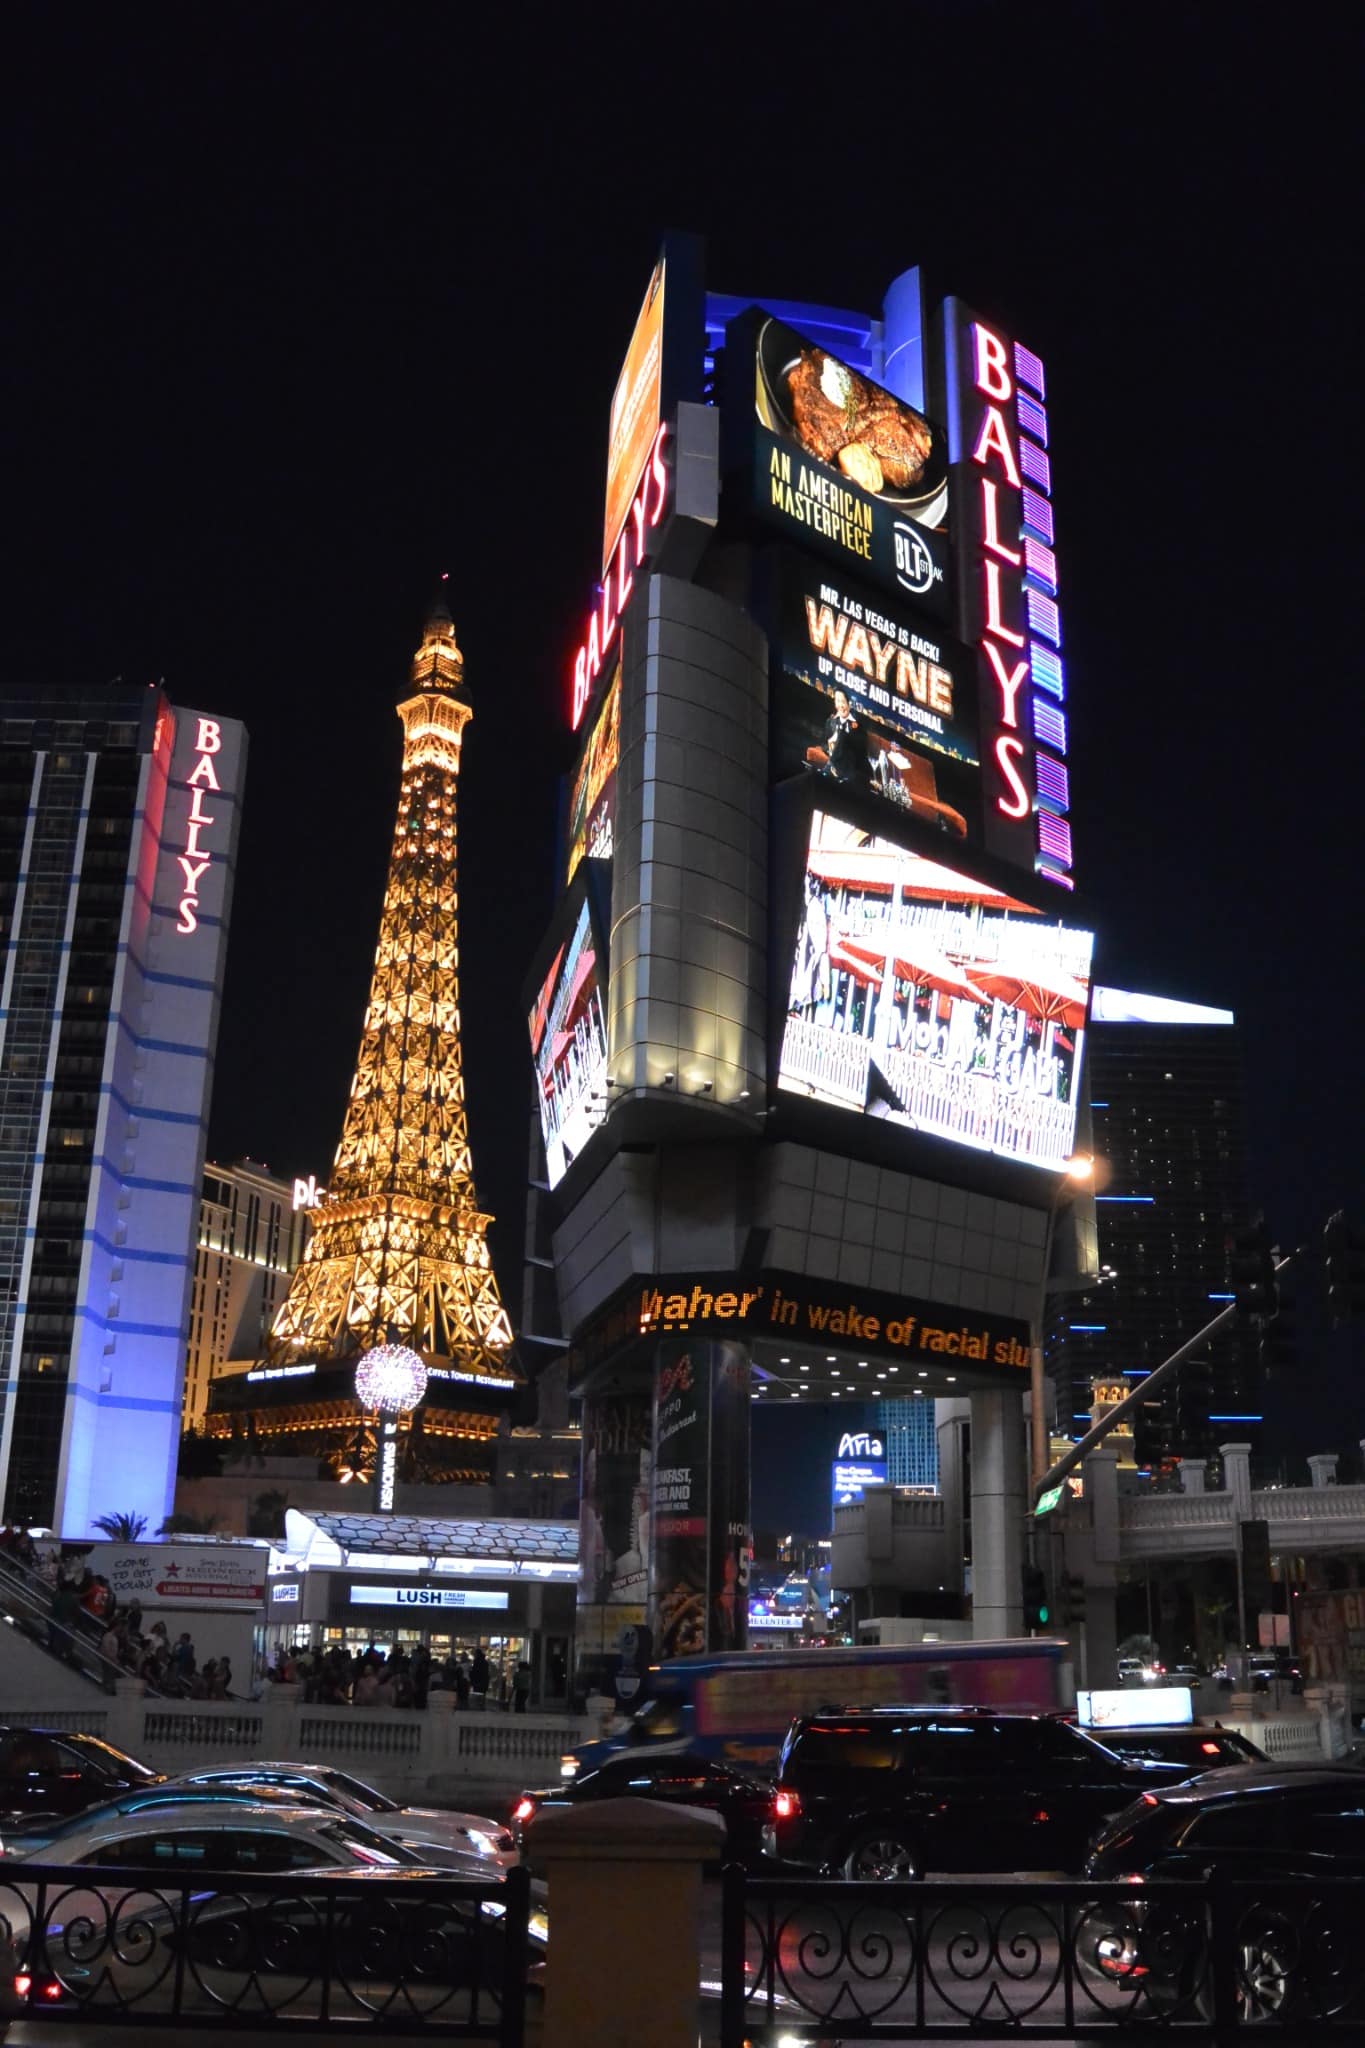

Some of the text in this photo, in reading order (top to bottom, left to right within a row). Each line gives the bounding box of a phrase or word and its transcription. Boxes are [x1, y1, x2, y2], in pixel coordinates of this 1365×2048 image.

[770, 447, 873, 534] AN AMERICAN
[771, 475, 873, 561] MASTERPIECE
[894, 532, 922, 581] BLT
[972, 321, 1030, 819] BALLYS
[804, 594, 954, 720] WAYNE
[820, 583, 940, 663] MR. LAS VEGAS IS BACK!
[818, 656, 945, 735] UP CLOSE AND PERSONAL
[176, 718, 222, 934] BALLYS
[770, 1290, 799, 1325] in
[807, 1303, 879, 1341] wake
[886, 1316, 916, 1346] of
[920, 1327, 989, 1361] racial
[838, 1433, 882, 1458] Aria
[396, 1590, 442, 1604] LUSH
